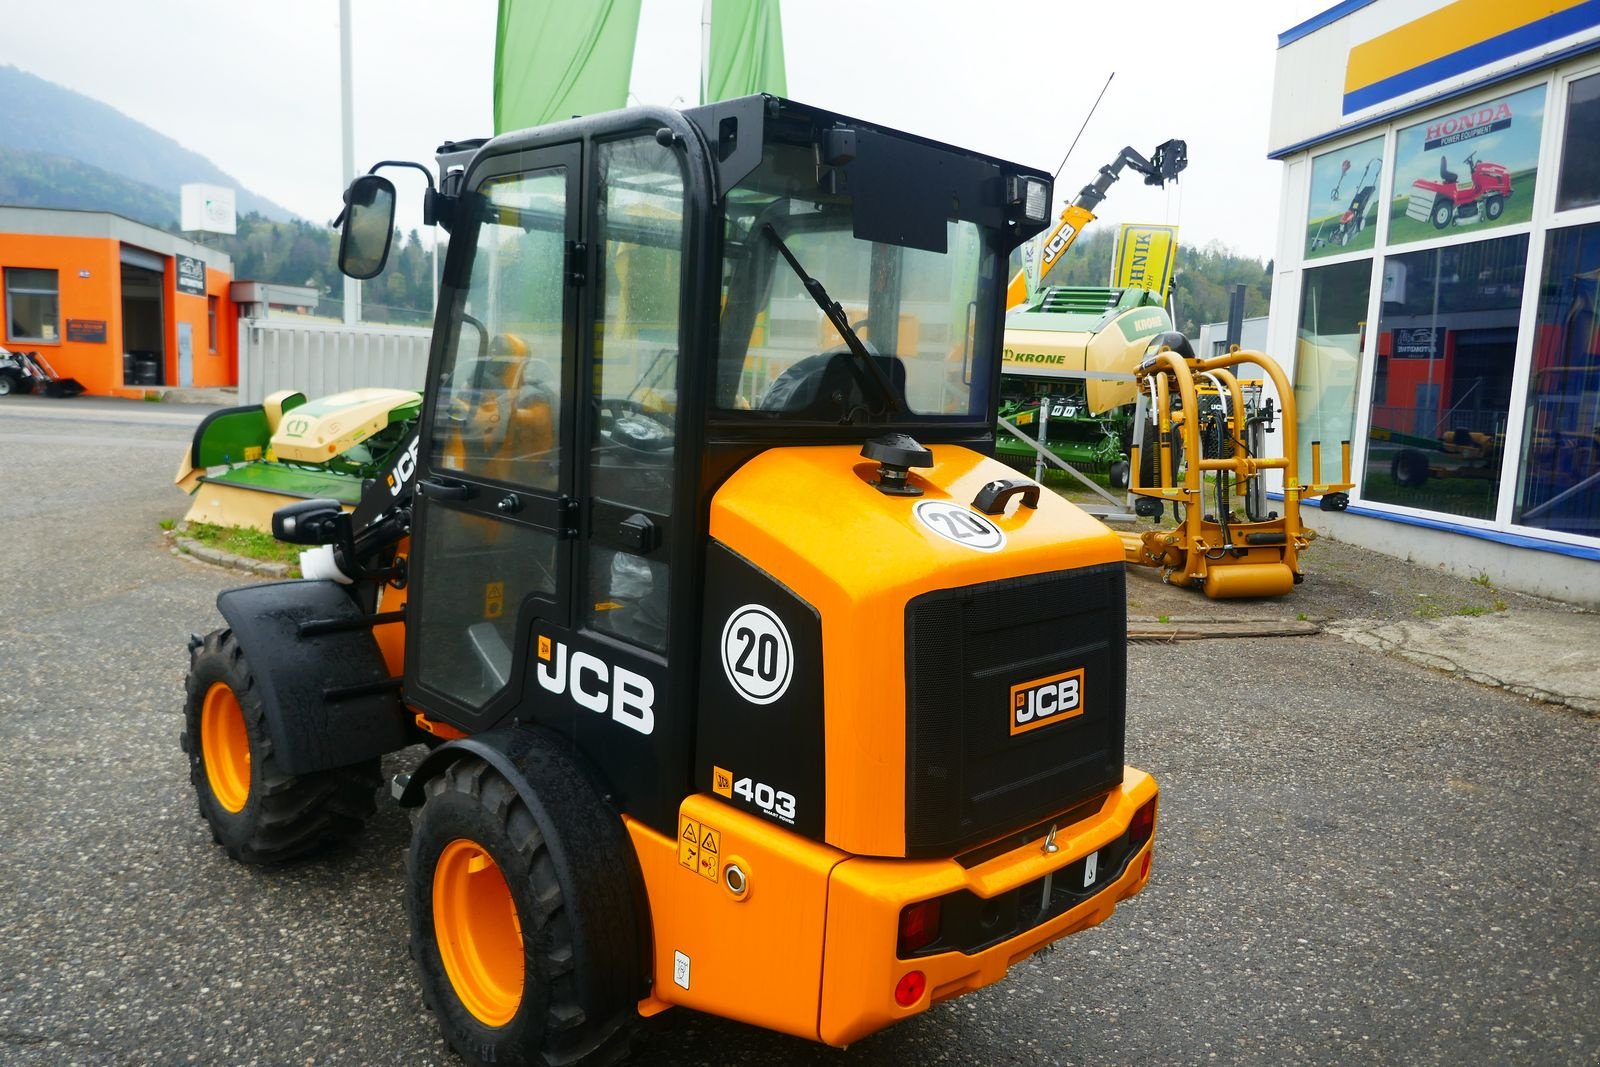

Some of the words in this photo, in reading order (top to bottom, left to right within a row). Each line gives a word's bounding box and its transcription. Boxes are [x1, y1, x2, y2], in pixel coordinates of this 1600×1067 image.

[1425, 103, 1512, 140] HONDA
[1441, 133, 1460, 145] POWER
[1460, 126, 1491, 140] EQUIPMENT
[1044, 223, 1076, 263] JCB
[1134, 316, 1163, 332] KRONE
[1014, 352, 1066, 364] KRONE
[928, 510, 991, 538] 20
[735, 626, 778, 682] 20
[537, 642, 655, 735] JCB
[1016, 679, 1079, 723] JCB
[734, 777, 796, 819] 403
